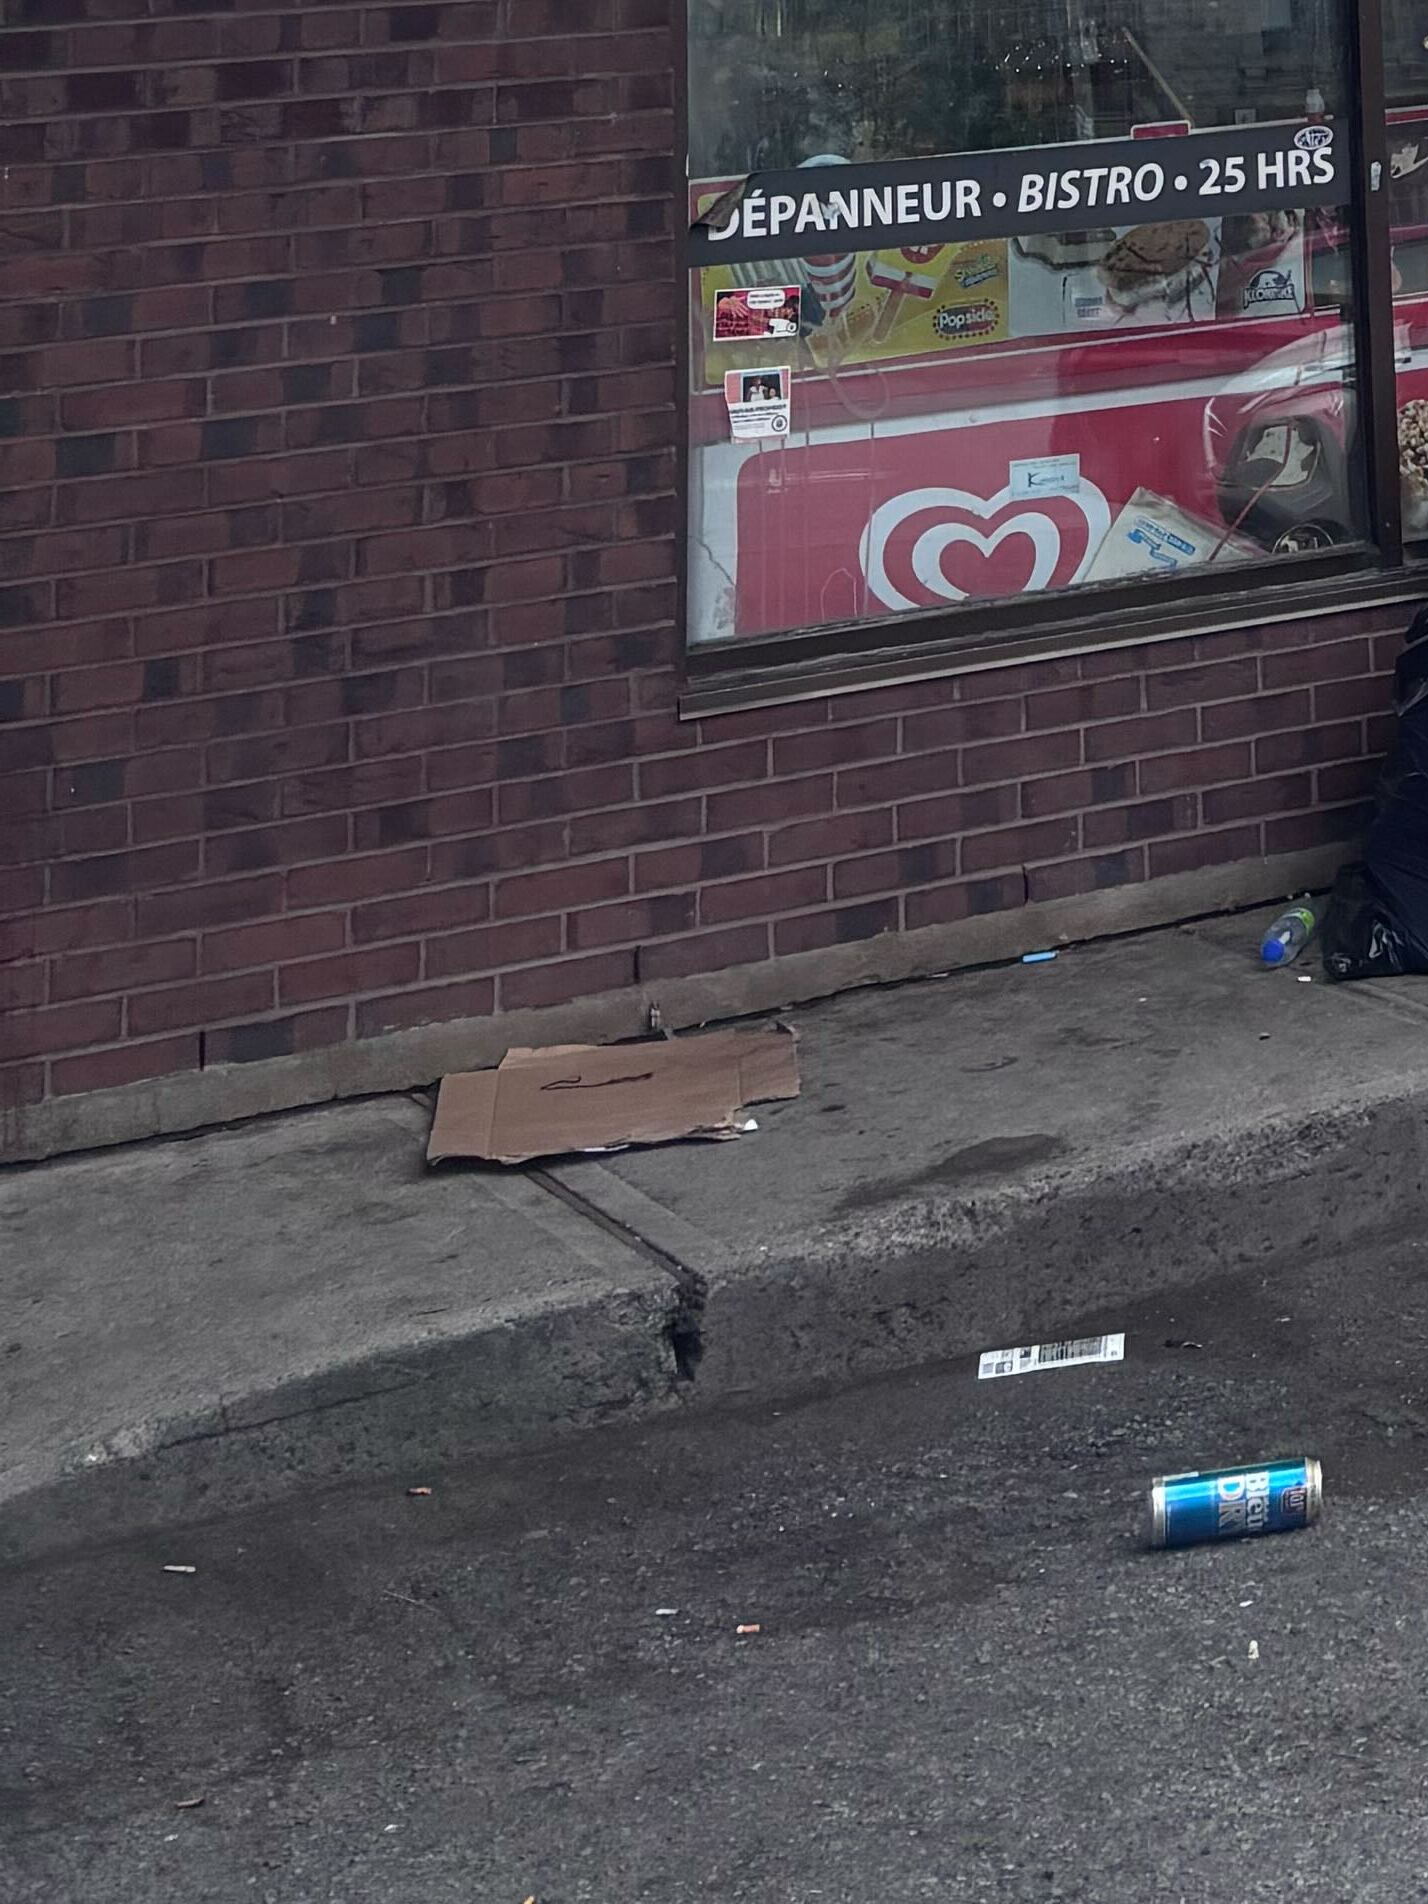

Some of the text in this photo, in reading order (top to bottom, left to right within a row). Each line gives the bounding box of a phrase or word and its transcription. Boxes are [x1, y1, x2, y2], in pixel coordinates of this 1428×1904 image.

[1017, 162, 1165, 213] BISTRO
[1198, 155, 1246, 196] 25
[1256, 146, 1335, 190] HRS
